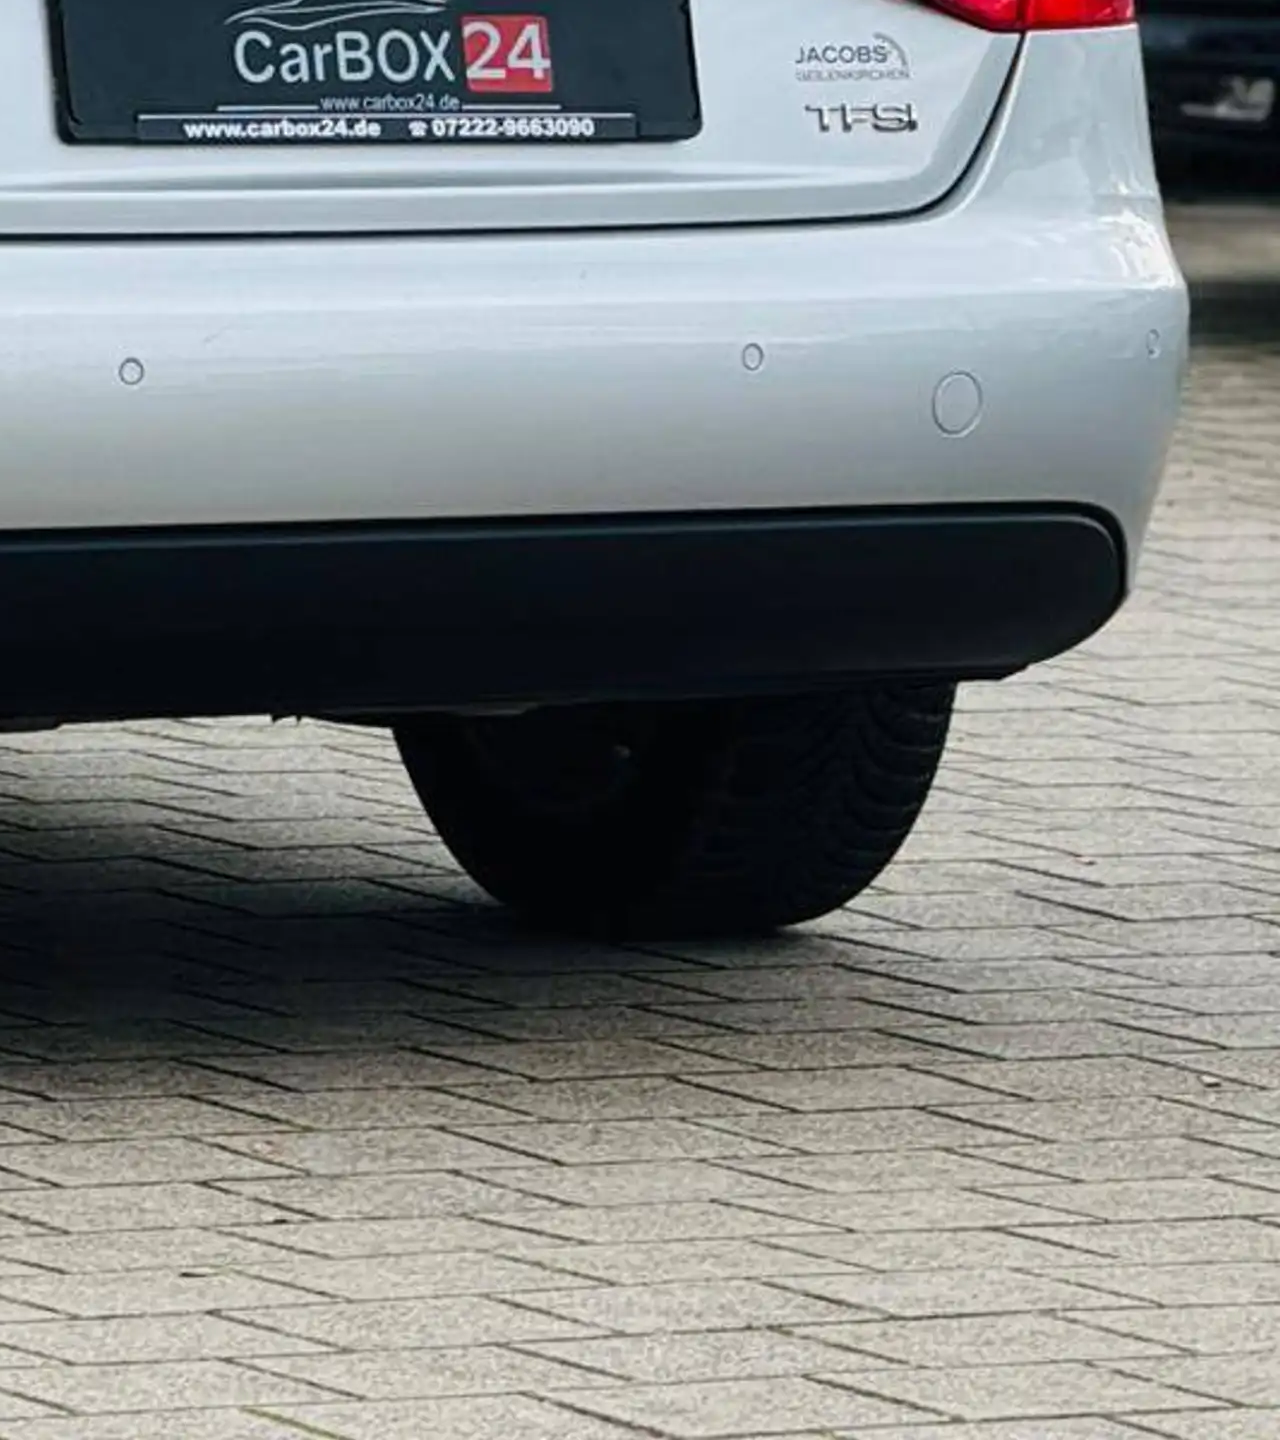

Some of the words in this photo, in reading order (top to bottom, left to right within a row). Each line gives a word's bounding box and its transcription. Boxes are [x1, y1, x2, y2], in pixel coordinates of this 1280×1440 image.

[795, 45, 889, 64] JACOBS
[804, 102, 918, 133] TFSI
[182, 119, 382, 139] www.carbox24.de
